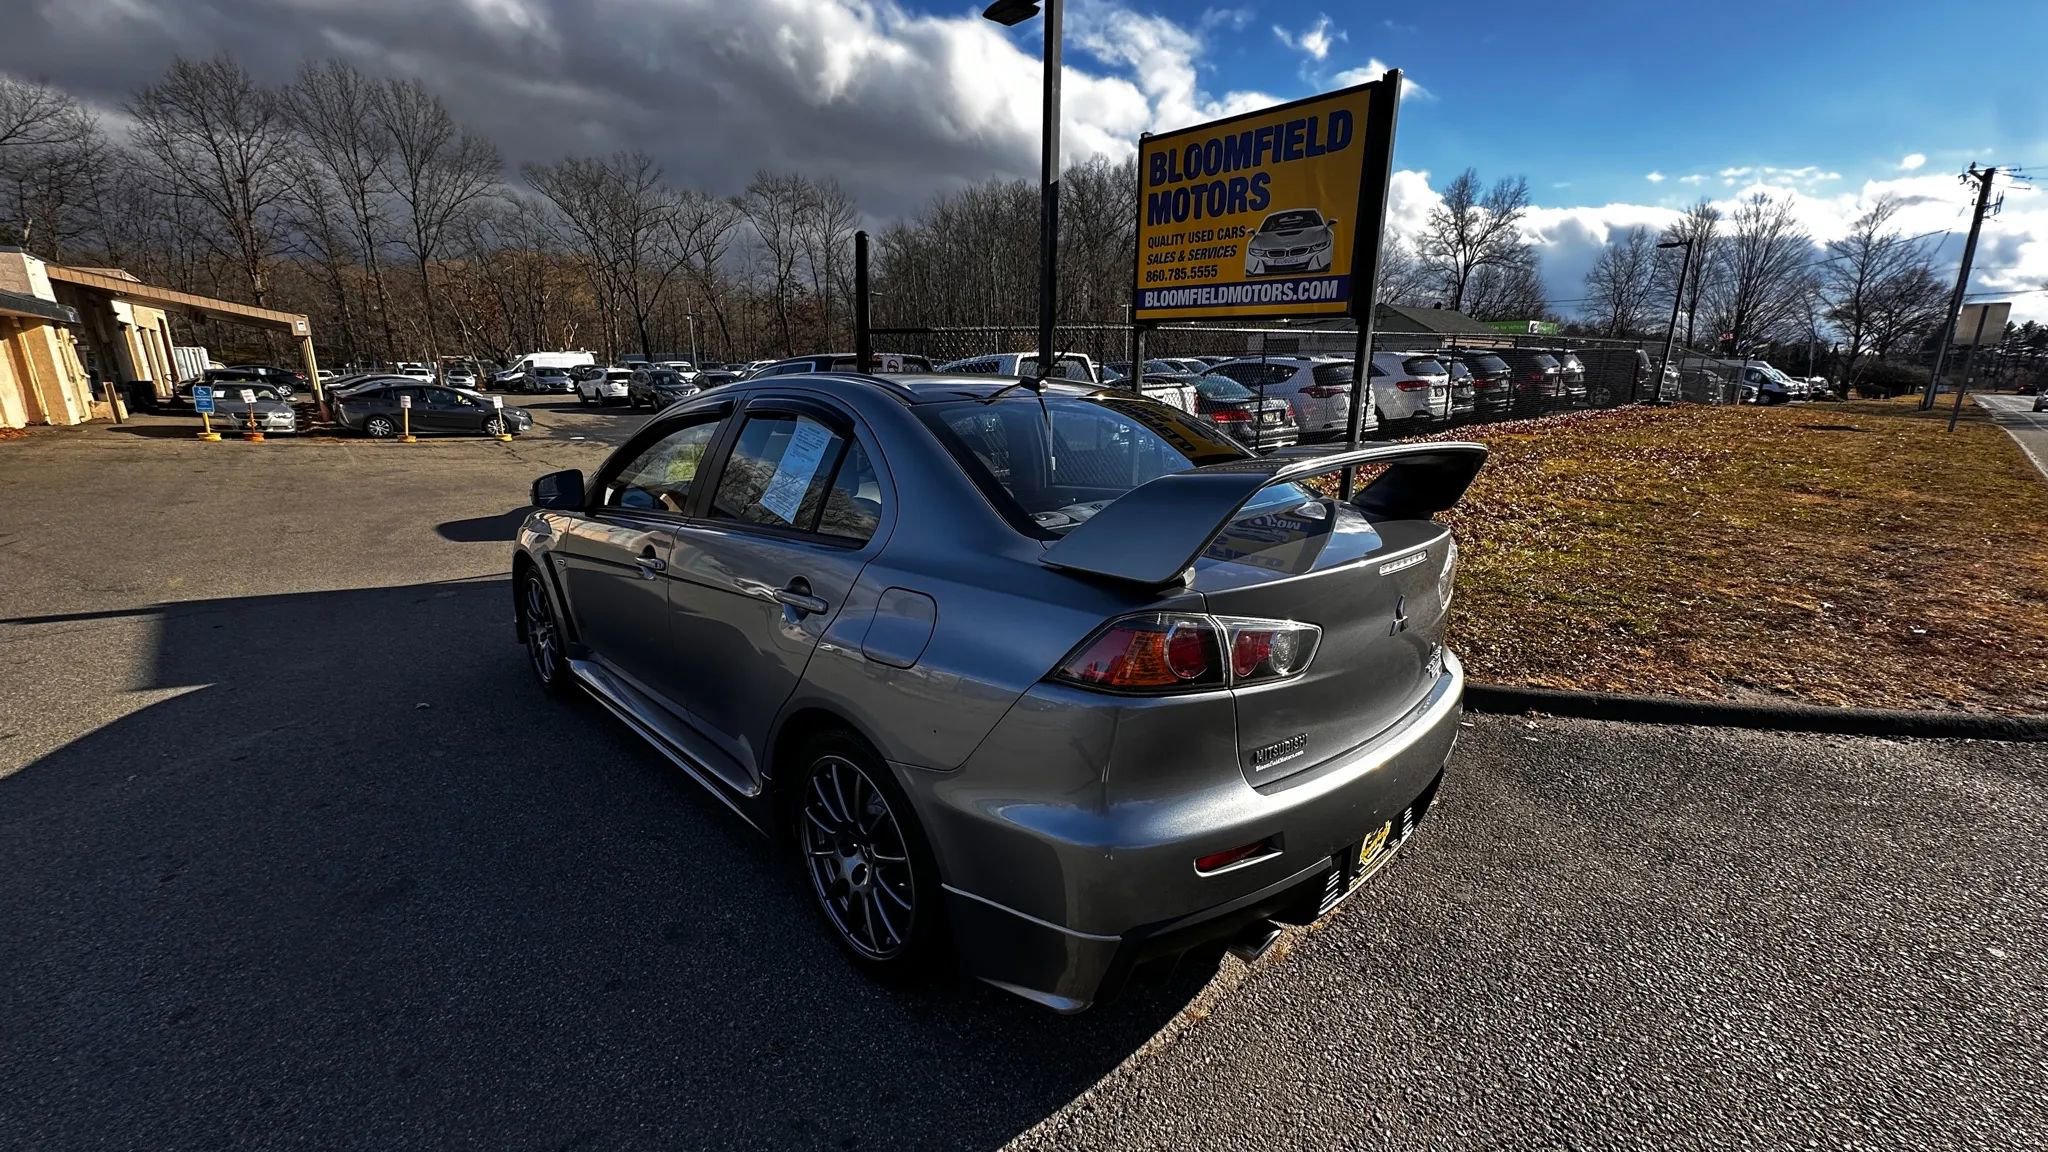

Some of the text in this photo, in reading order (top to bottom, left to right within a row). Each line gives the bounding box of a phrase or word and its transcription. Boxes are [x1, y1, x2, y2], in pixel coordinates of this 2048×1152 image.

[1149, 109, 1354, 187] BLOOMFIELD
[1147, 172, 1271, 226] MOTORS
[1148, 225, 1246, 249] QUALITY USED CARS
[1147, 245, 1238, 265] SALES & SERVICES
[1146, 265, 1218, 282] 860.785.5555
[1145, 280, 1338, 308] BLOOMFIELDMOTORS.COM
[1256, 733, 1308, 763] MITSUBISHI
